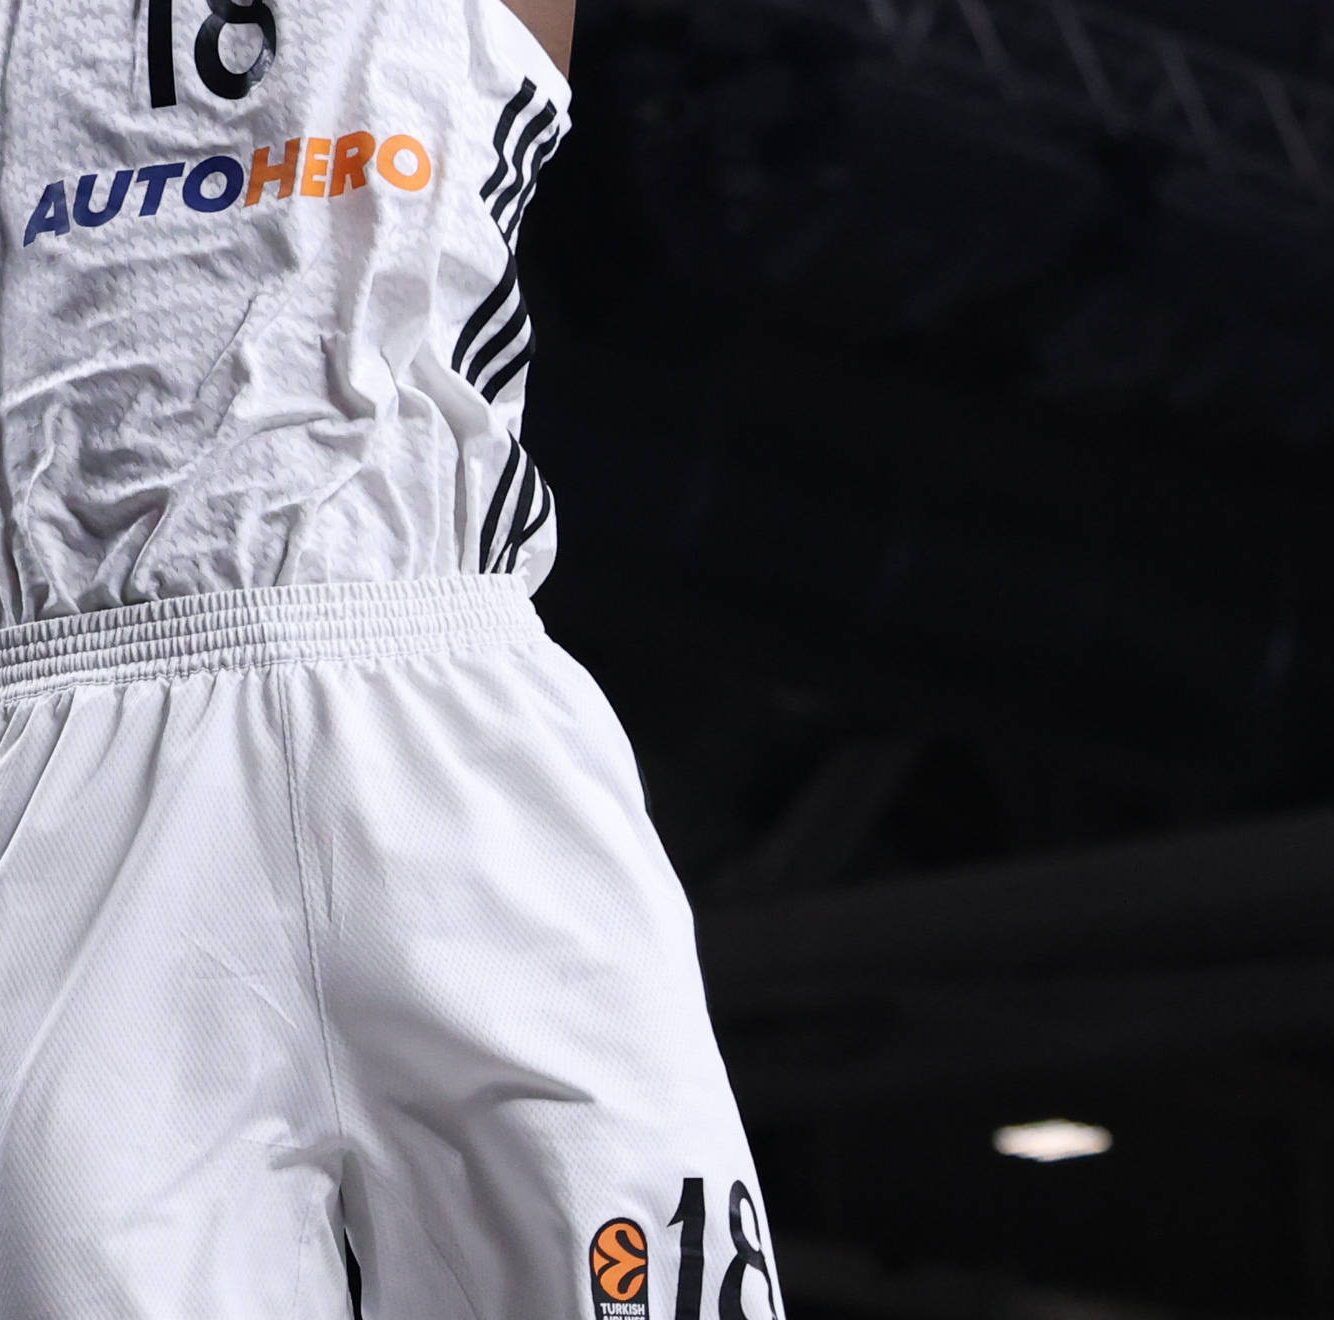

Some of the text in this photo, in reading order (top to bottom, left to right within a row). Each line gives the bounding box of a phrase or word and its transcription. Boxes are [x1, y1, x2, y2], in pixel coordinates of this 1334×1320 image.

[23, 130, 431, 247] AUTOHERO
[666, 1177, 779, 1320] 18
[600, 1302, 646, 1315] TURKISH
